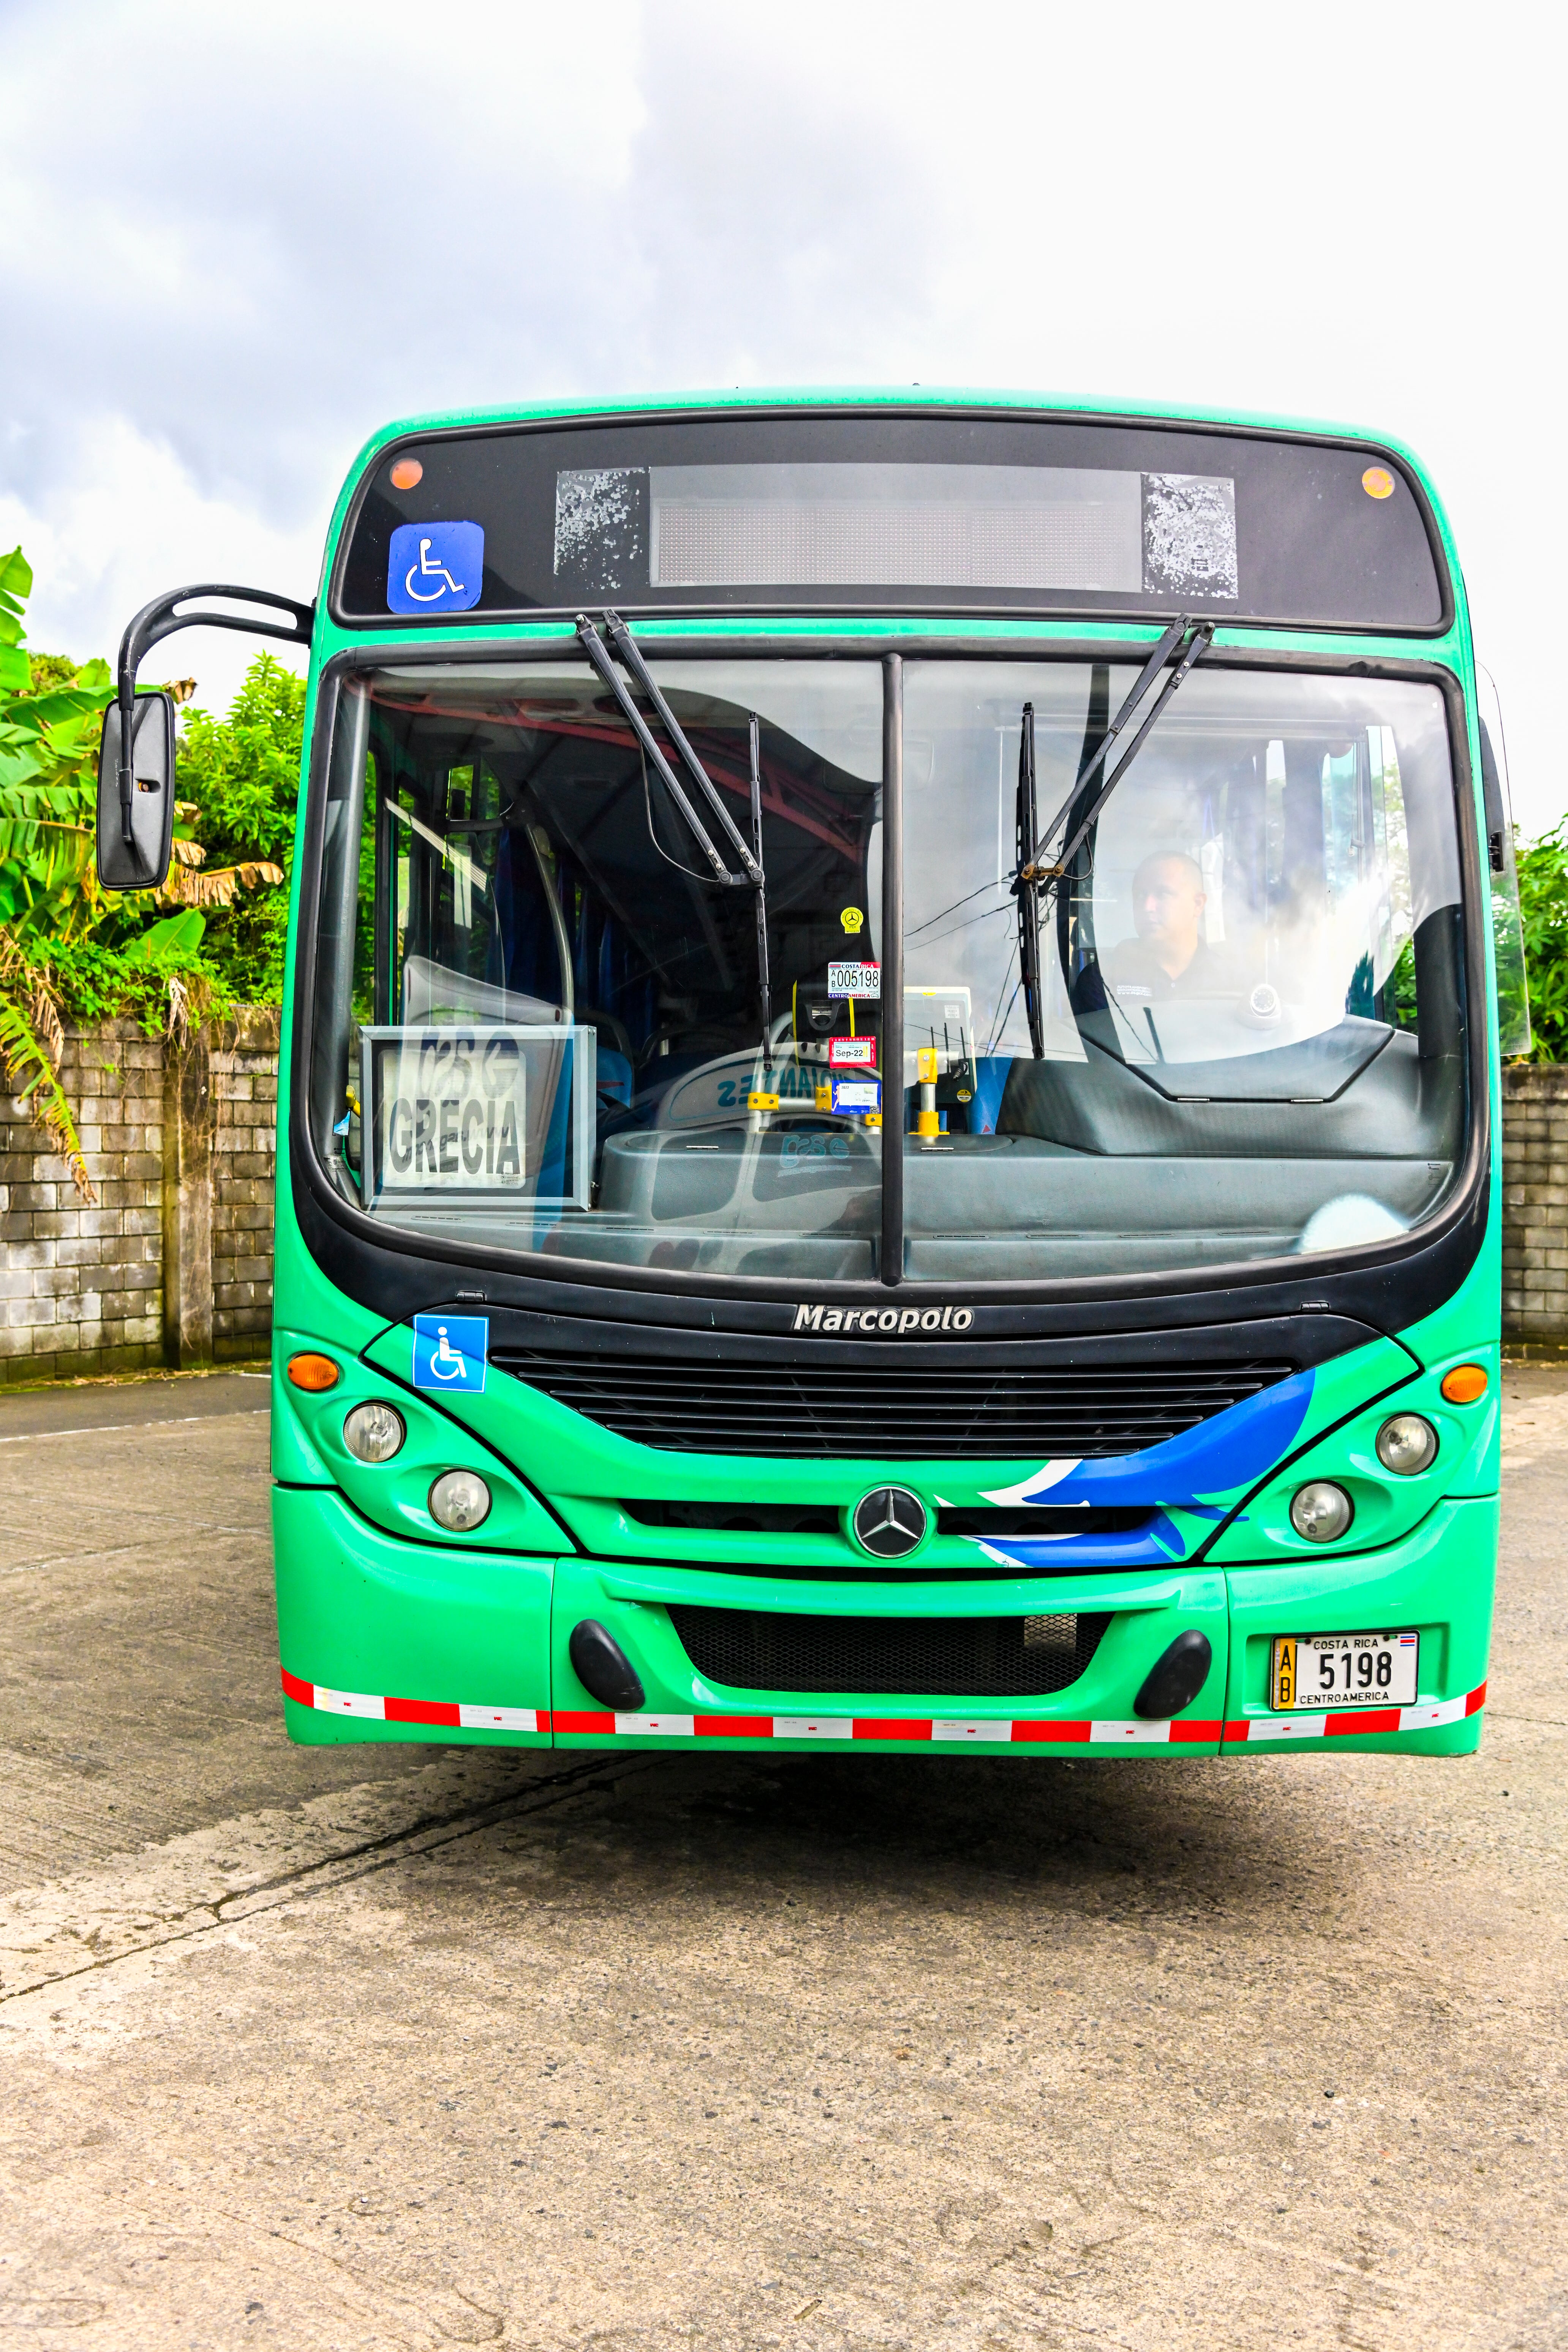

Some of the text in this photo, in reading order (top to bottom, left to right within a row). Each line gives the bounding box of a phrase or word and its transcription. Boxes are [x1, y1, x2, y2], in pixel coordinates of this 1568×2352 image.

[837, 970, 879, 987] 005198
[836, 1050, 863, 1058] Sep-22
[390, 1098, 520, 1175] GRECIA
[793, 1304, 973, 1334] Marcopolo
[1314, 1639, 1378, 1650] COSTA RICA
[1280, 1645, 1291, 1671] A
[1319, 1651, 1392, 1690] 5198
[1280, 1677, 1290, 1702] B
[1300, 1691, 1389, 1704] CENTROAMERICA
